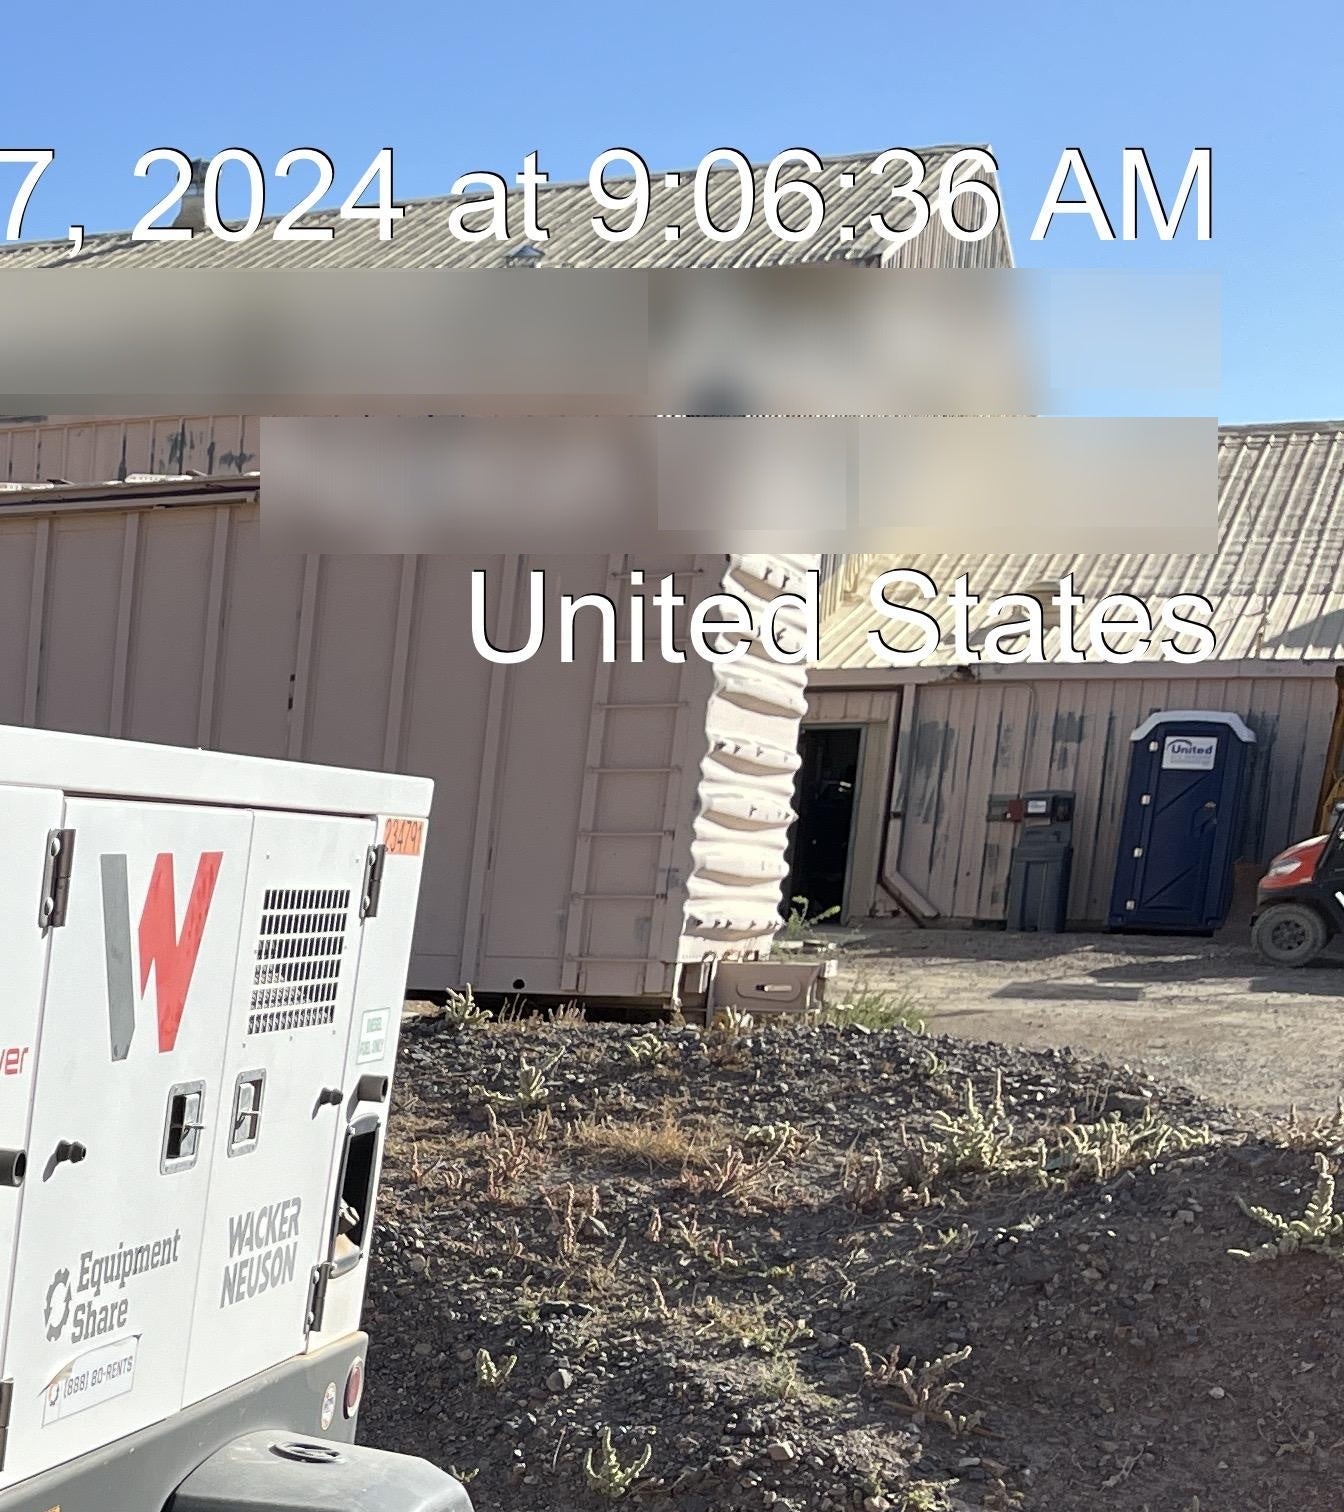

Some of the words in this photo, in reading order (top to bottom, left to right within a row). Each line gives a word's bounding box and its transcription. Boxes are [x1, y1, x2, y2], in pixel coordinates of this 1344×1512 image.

[1171, 745, 1213, 754] United
[229, 1196, 302, 1258] WACKER
[76, 1228, 181, 1297] Equipment
[219, 1241, 298, 1309] NEUSON
[70, 1298, 129, 1344] Share
[63, 1370, 89, 1399] (888)
[91, 1355, 134, 1389] 80-RENTS
